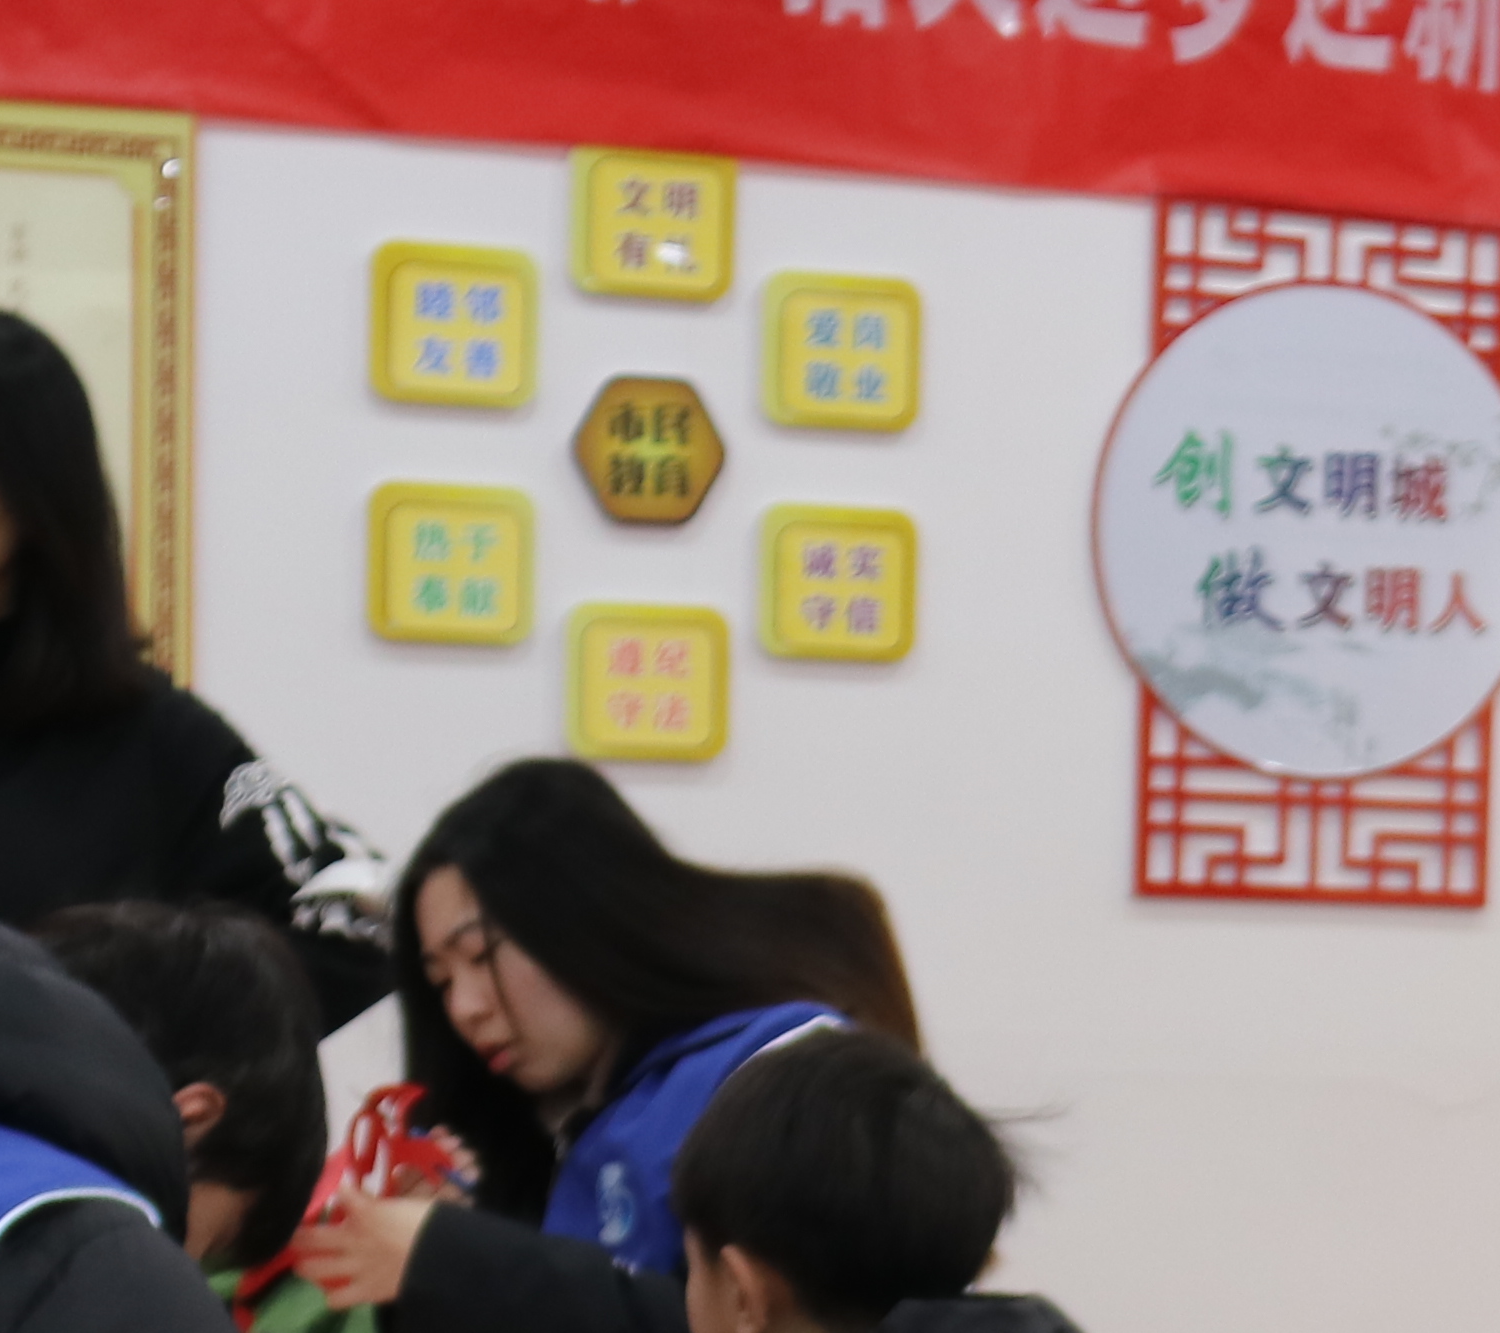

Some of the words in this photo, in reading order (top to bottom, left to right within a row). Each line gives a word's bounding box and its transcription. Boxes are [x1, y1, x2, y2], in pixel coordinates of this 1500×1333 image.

[616, 179, 700, 220] 文明
[414, 336, 500, 377] 友善
[1154, 428, 1448, 522] 创文明城
[1196, 545, 1486, 633] 做文明人
